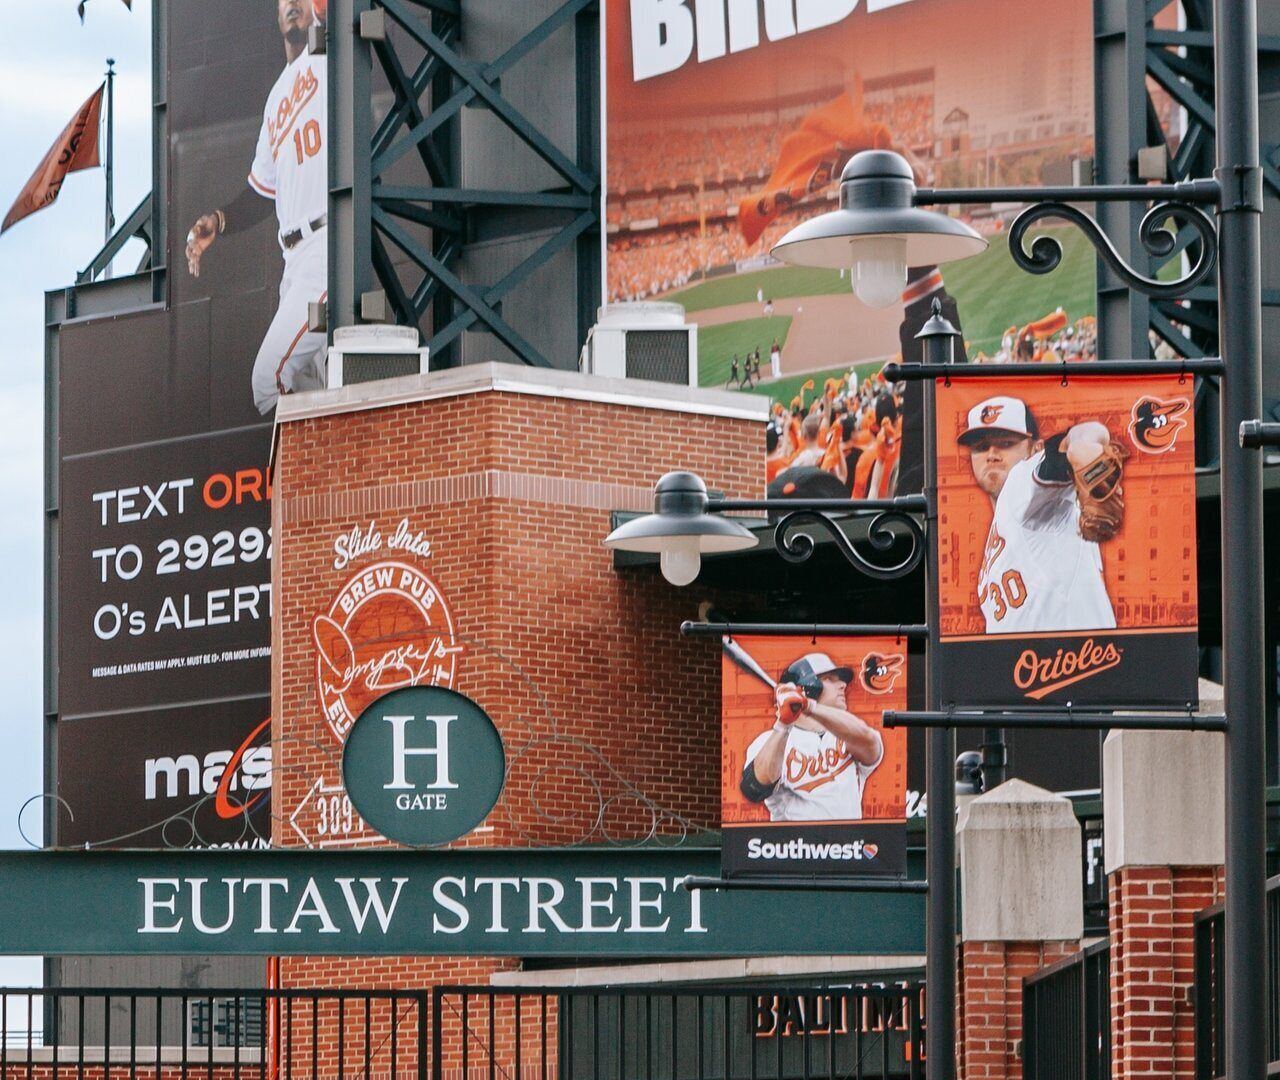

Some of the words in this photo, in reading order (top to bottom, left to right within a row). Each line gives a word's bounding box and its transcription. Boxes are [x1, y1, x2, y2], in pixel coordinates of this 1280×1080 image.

[293, 118, 322, 166] 10
[92, 478, 194, 526] TEXT
[92, 543, 143, 583] TO
[333, 519, 382, 570] Slide
[387, 516, 431, 558] Into
[340, 567, 395, 615] BREW
[399, 570, 436, 610] PUB
[990, 568, 1028, 622] 30
[93, 602, 146, 640] O's
[92, 664, 118, 678] MESSAGE
[123, 663, 137, 674] DATA
[137, 660, 154, 672] RATES
[155, 659, 167, 670] MAY
[186, 655, 203, 667] MUST
[203, 653, 211, 664] BE
[221, 650, 233, 662] FOR
[233, 649, 250, 661] MORE
[250, 646, 272, 658] INFORM
[314, 615, 464, 697] Dempsey's
[1013, 638, 1122, 700] Orioles
[144, 746, 272, 800] mas
[382, 714, 460, 790] H
[785, 736, 849, 784] Oriol
[395, 793, 448, 811] GATE
[747, 837, 863, 860] Southwest
[137, 876, 409, 935] EUTAW
[431, 876, 708, 935] STREET
